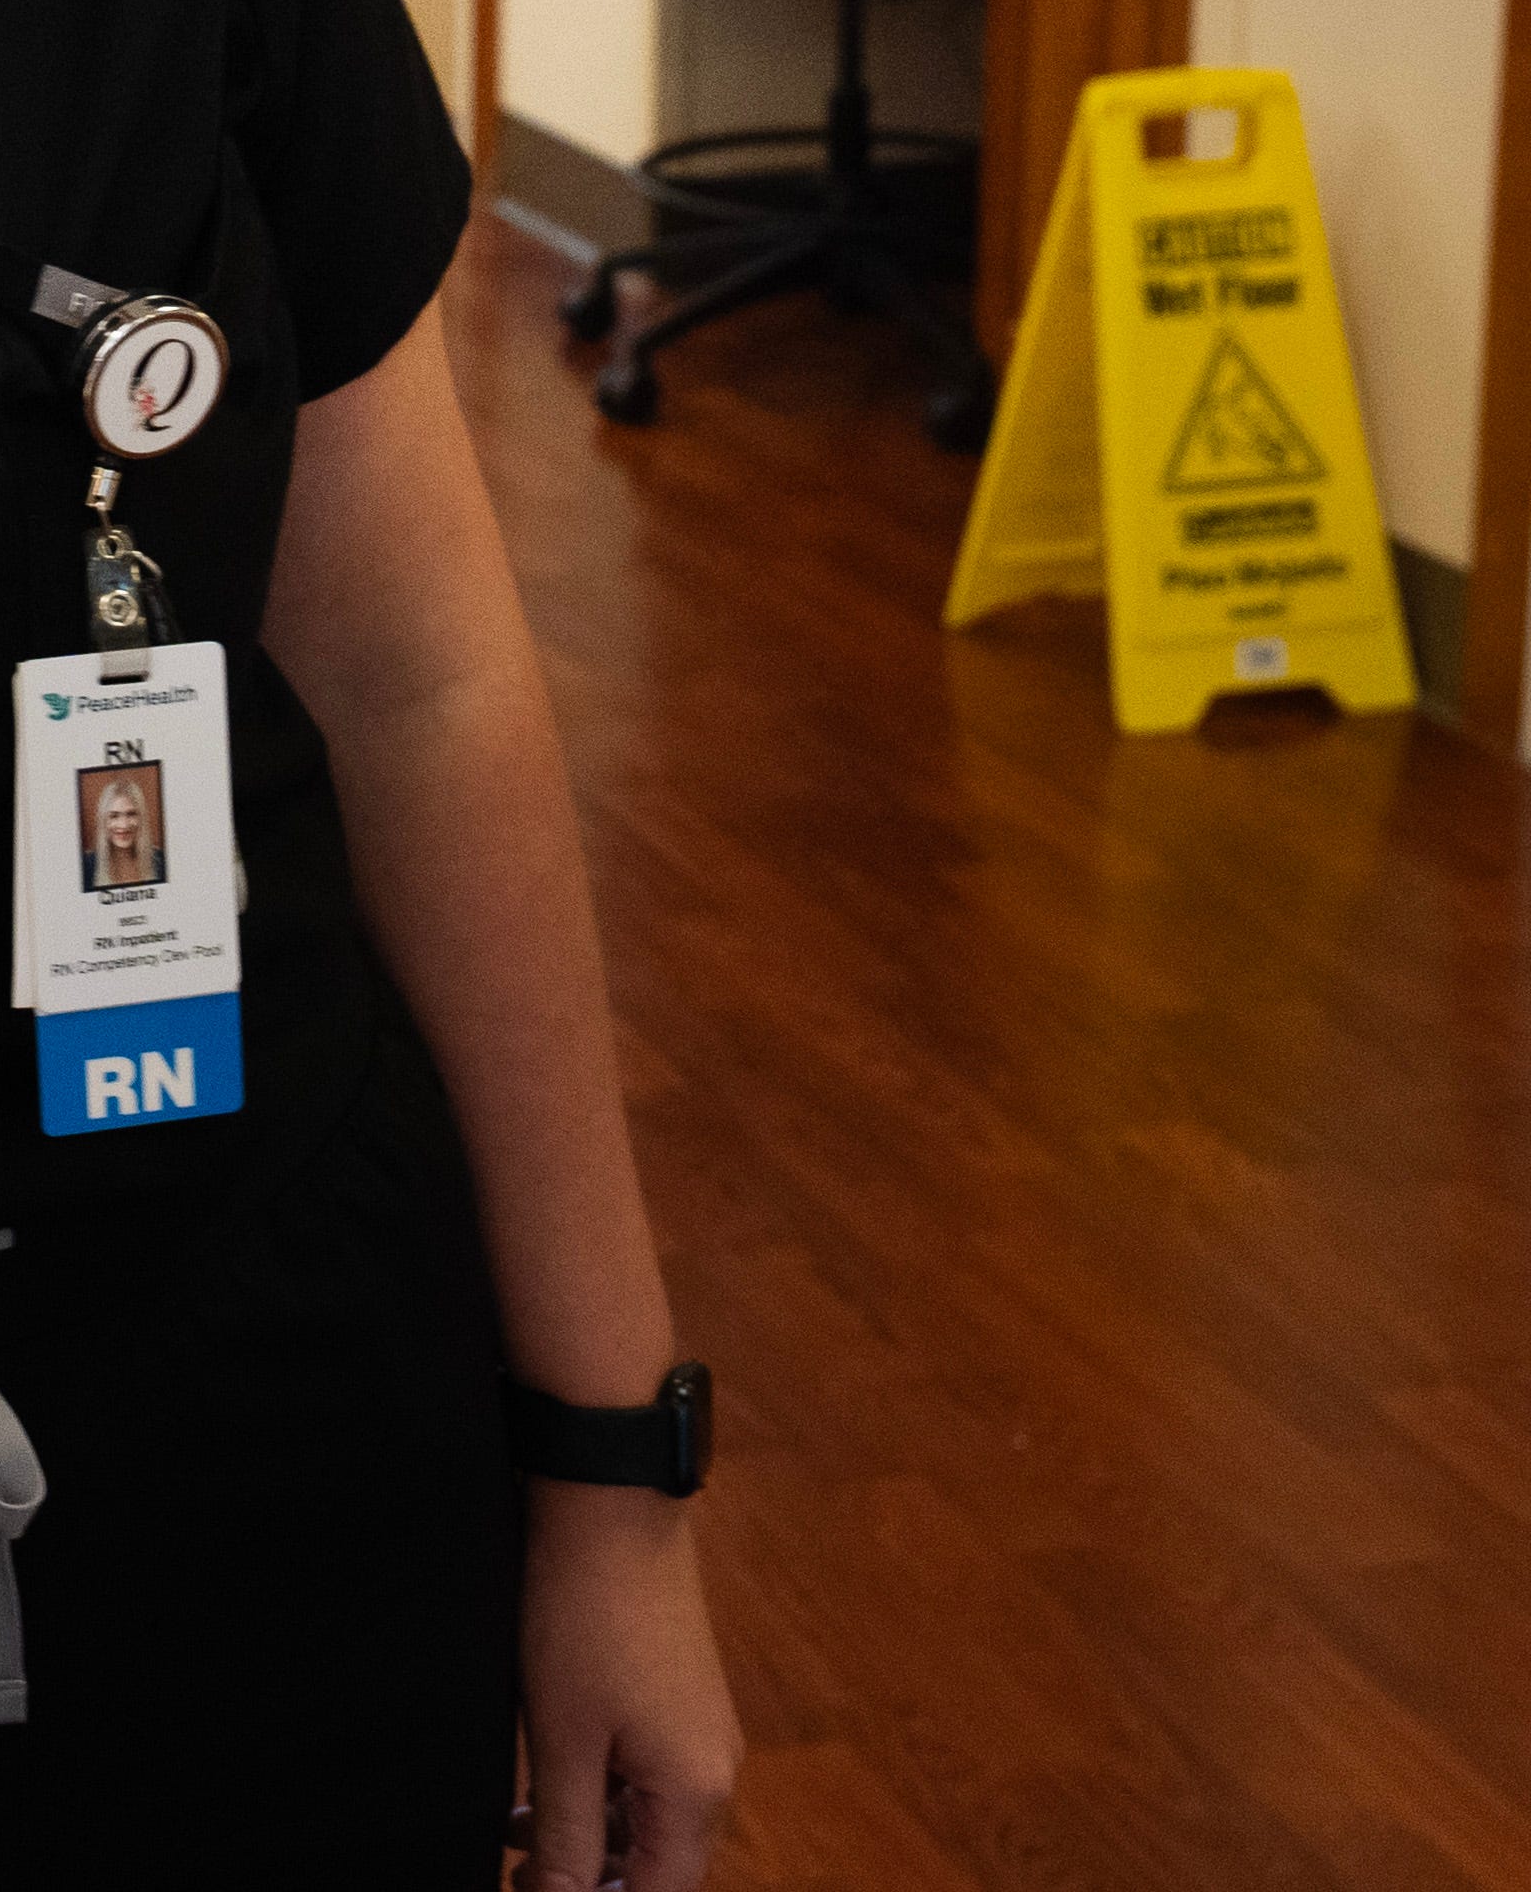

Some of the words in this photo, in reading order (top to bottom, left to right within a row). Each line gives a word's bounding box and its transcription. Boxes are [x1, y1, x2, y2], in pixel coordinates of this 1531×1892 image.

[128, 338, 196, 432] Q
[77, 685, 197, 713] PeaceHealth
[104, 739, 145, 764] RN
[84, 1047, 197, 1120] RN
